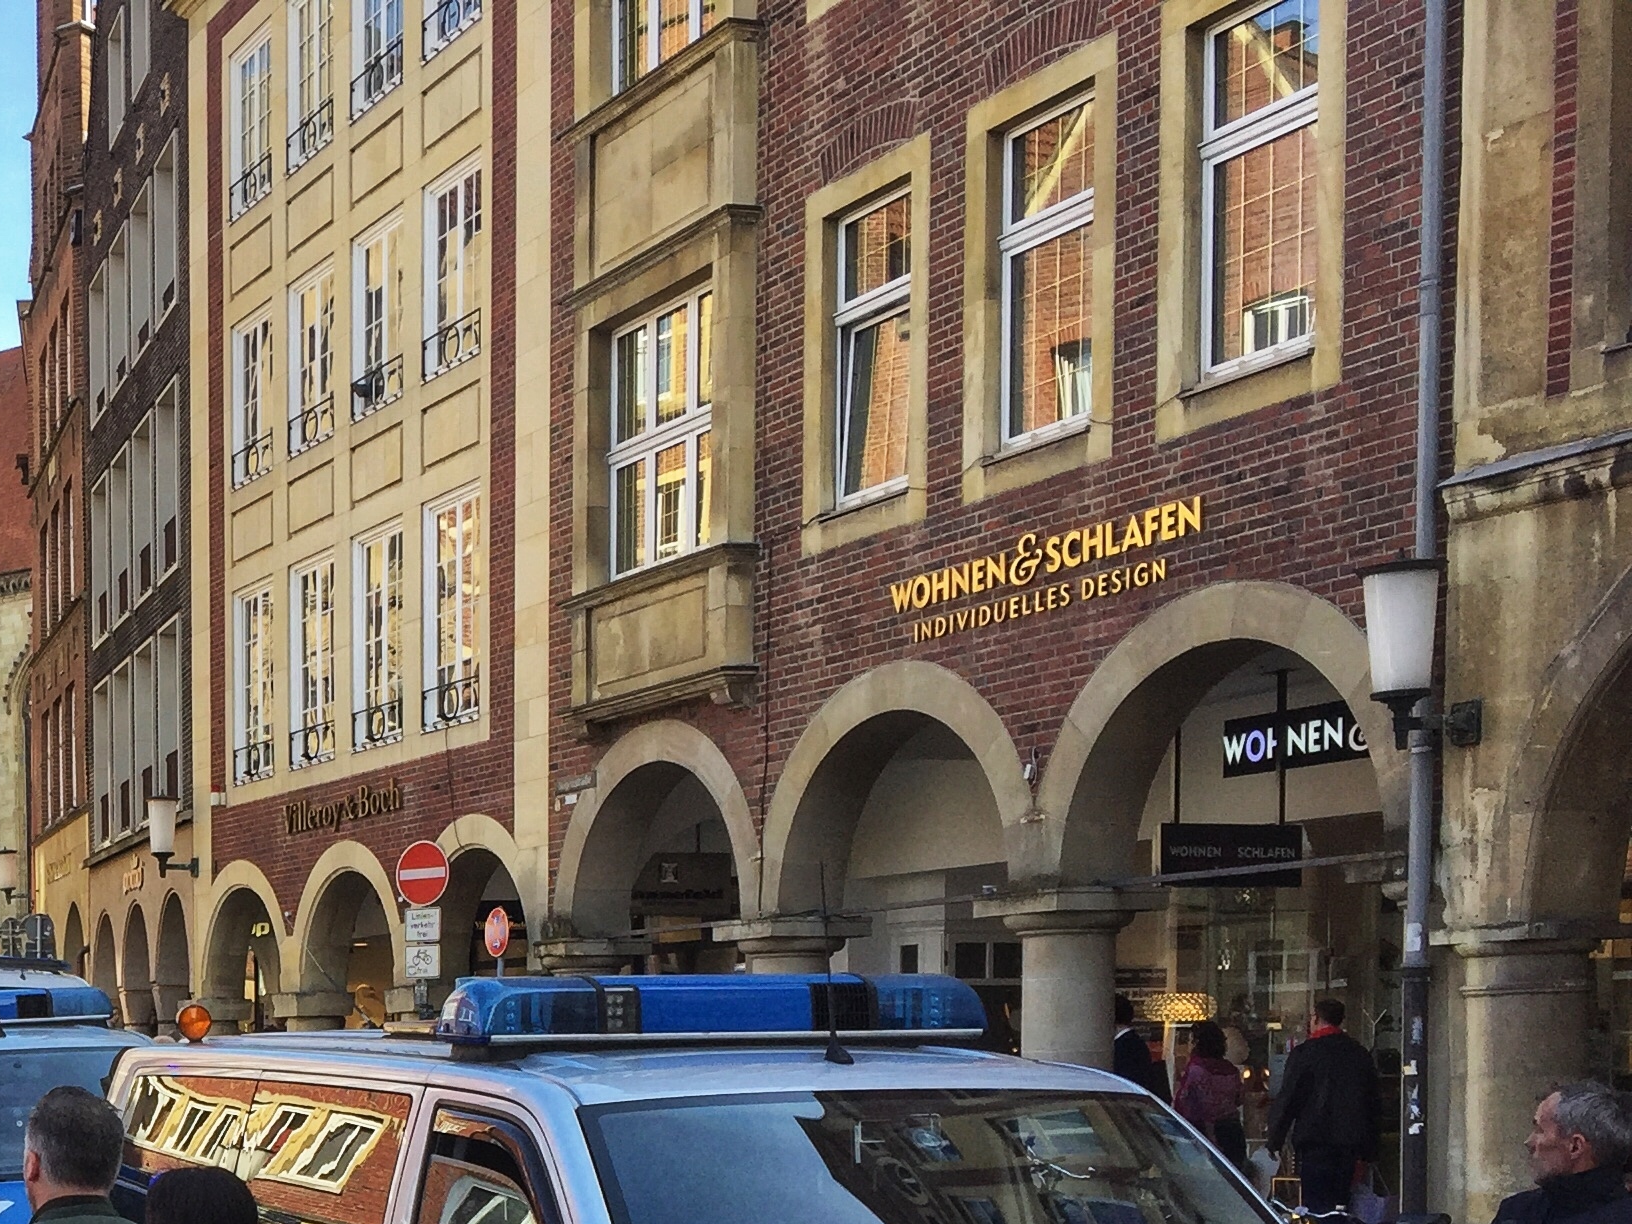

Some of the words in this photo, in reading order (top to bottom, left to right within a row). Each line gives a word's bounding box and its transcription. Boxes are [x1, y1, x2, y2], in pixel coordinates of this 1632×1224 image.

[890, 553, 1006, 613] WOHNEN
[1009, 533, 1043, 586] &
[1045, 496, 1201, 573] SCHLAFEN
[913, 583, 1070, 643] INDIVIDUELLES
[1080, 558, 1166, 600] DESIGN
[283, 799, 342, 834] Villeroy
[344, 795, 356, 821] &
[357, 777, 402, 819] Boch
[1169, 846, 1222, 858] WOHNEN
[1237, 847, 1296, 859] SCHLAFEN
